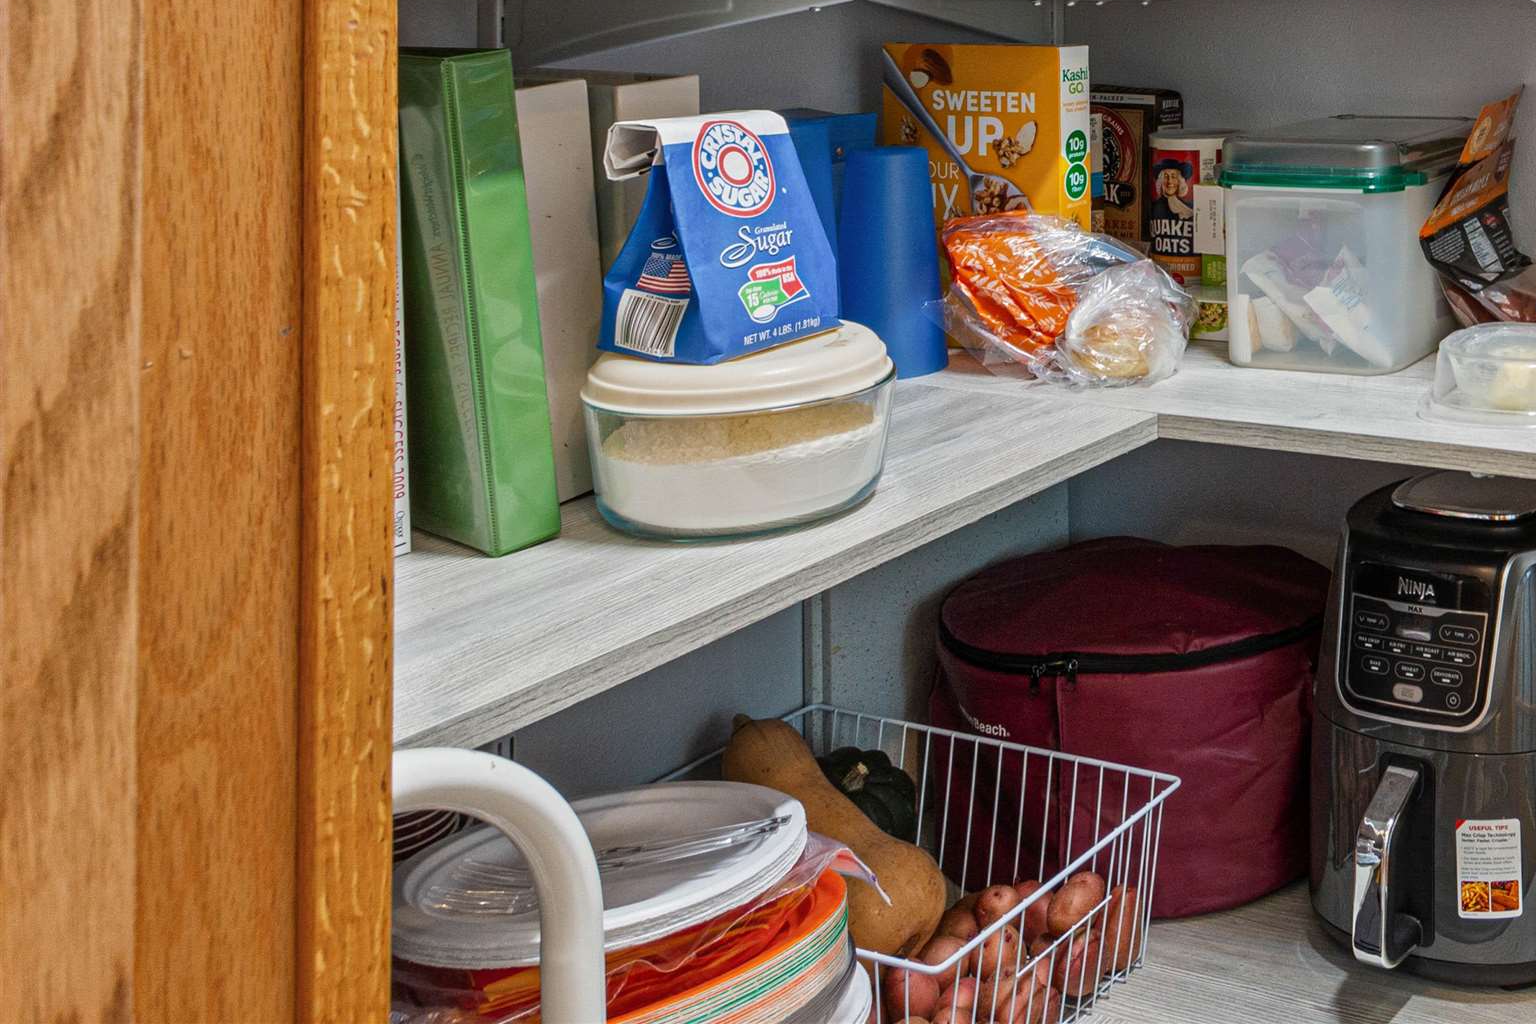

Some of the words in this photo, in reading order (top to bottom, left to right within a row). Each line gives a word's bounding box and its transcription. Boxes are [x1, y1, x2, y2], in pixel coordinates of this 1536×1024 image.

[1062, 67, 1089, 83] Kashi
[1068, 81, 1085, 95] GO
[931, 89, 1037, 114] SWEETEN
[946, 115, 1005, 157] UP
[1069, 135, 1085, 150] 10g
[700, 123, 765, 171] CRYSTAL
[929, 159, 960, 180] OUR
[1068, 172, 1085, 186] 10g
[708, 170, 772, 209] SUGAR
[1150, 218, 1194, 238] QUAKE
[720, 225, 793, 268] Sugar
[1154, 238, 1191, 254] OATS
[782, 273, 796, 283] USA
[749, 294, 760, 308] 15
[744, 334, 758, 346] NET
[759, 331, 773, 343] WT.
[773, 330, 778, 338] 4
[778, 325, 794, 337] LBS.
[1397, 576, 1436, 600] NINJA
[1408, 605, 1424, 613] MAX
